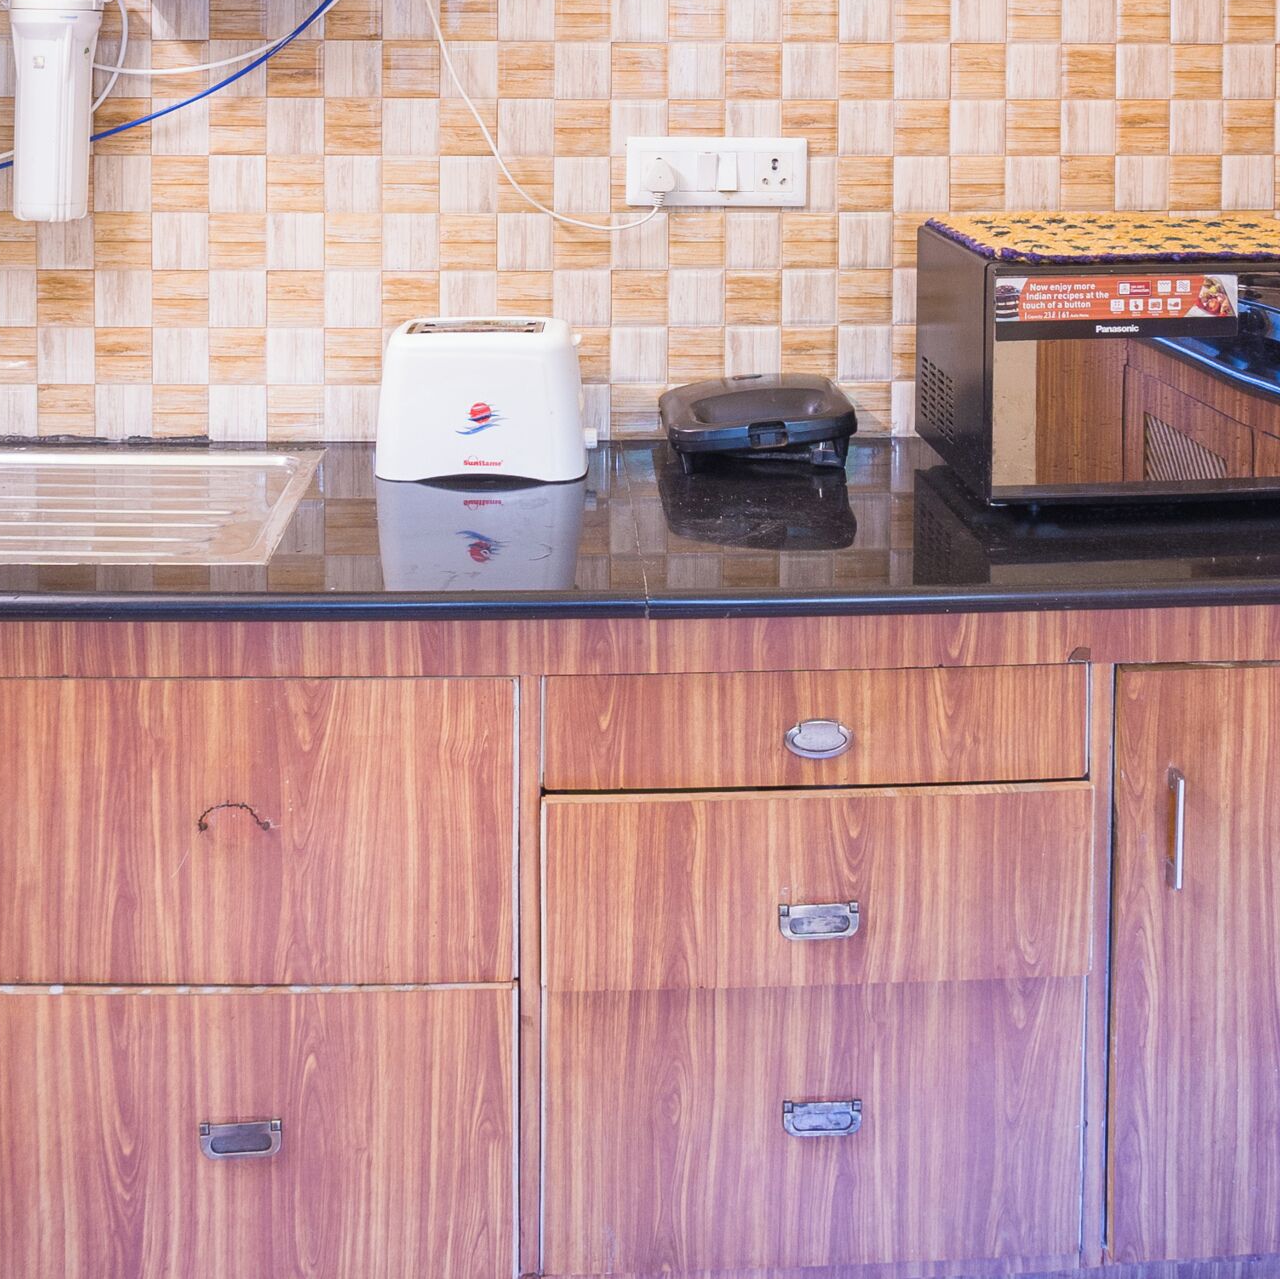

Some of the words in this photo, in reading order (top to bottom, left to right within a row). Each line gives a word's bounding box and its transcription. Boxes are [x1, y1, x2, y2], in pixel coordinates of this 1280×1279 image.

[1029, 283, 1048, 291] Now
[1049, 283, 1072, 292] enjoy
[1026, 292, 1052, 300] Indian
[1053, 292, 1084, 301] recipes
[1047, 301, 1056, 309] of
[1064, 301, 1091, 309] button
[1095, 323, 1139, 333] Panasonic
